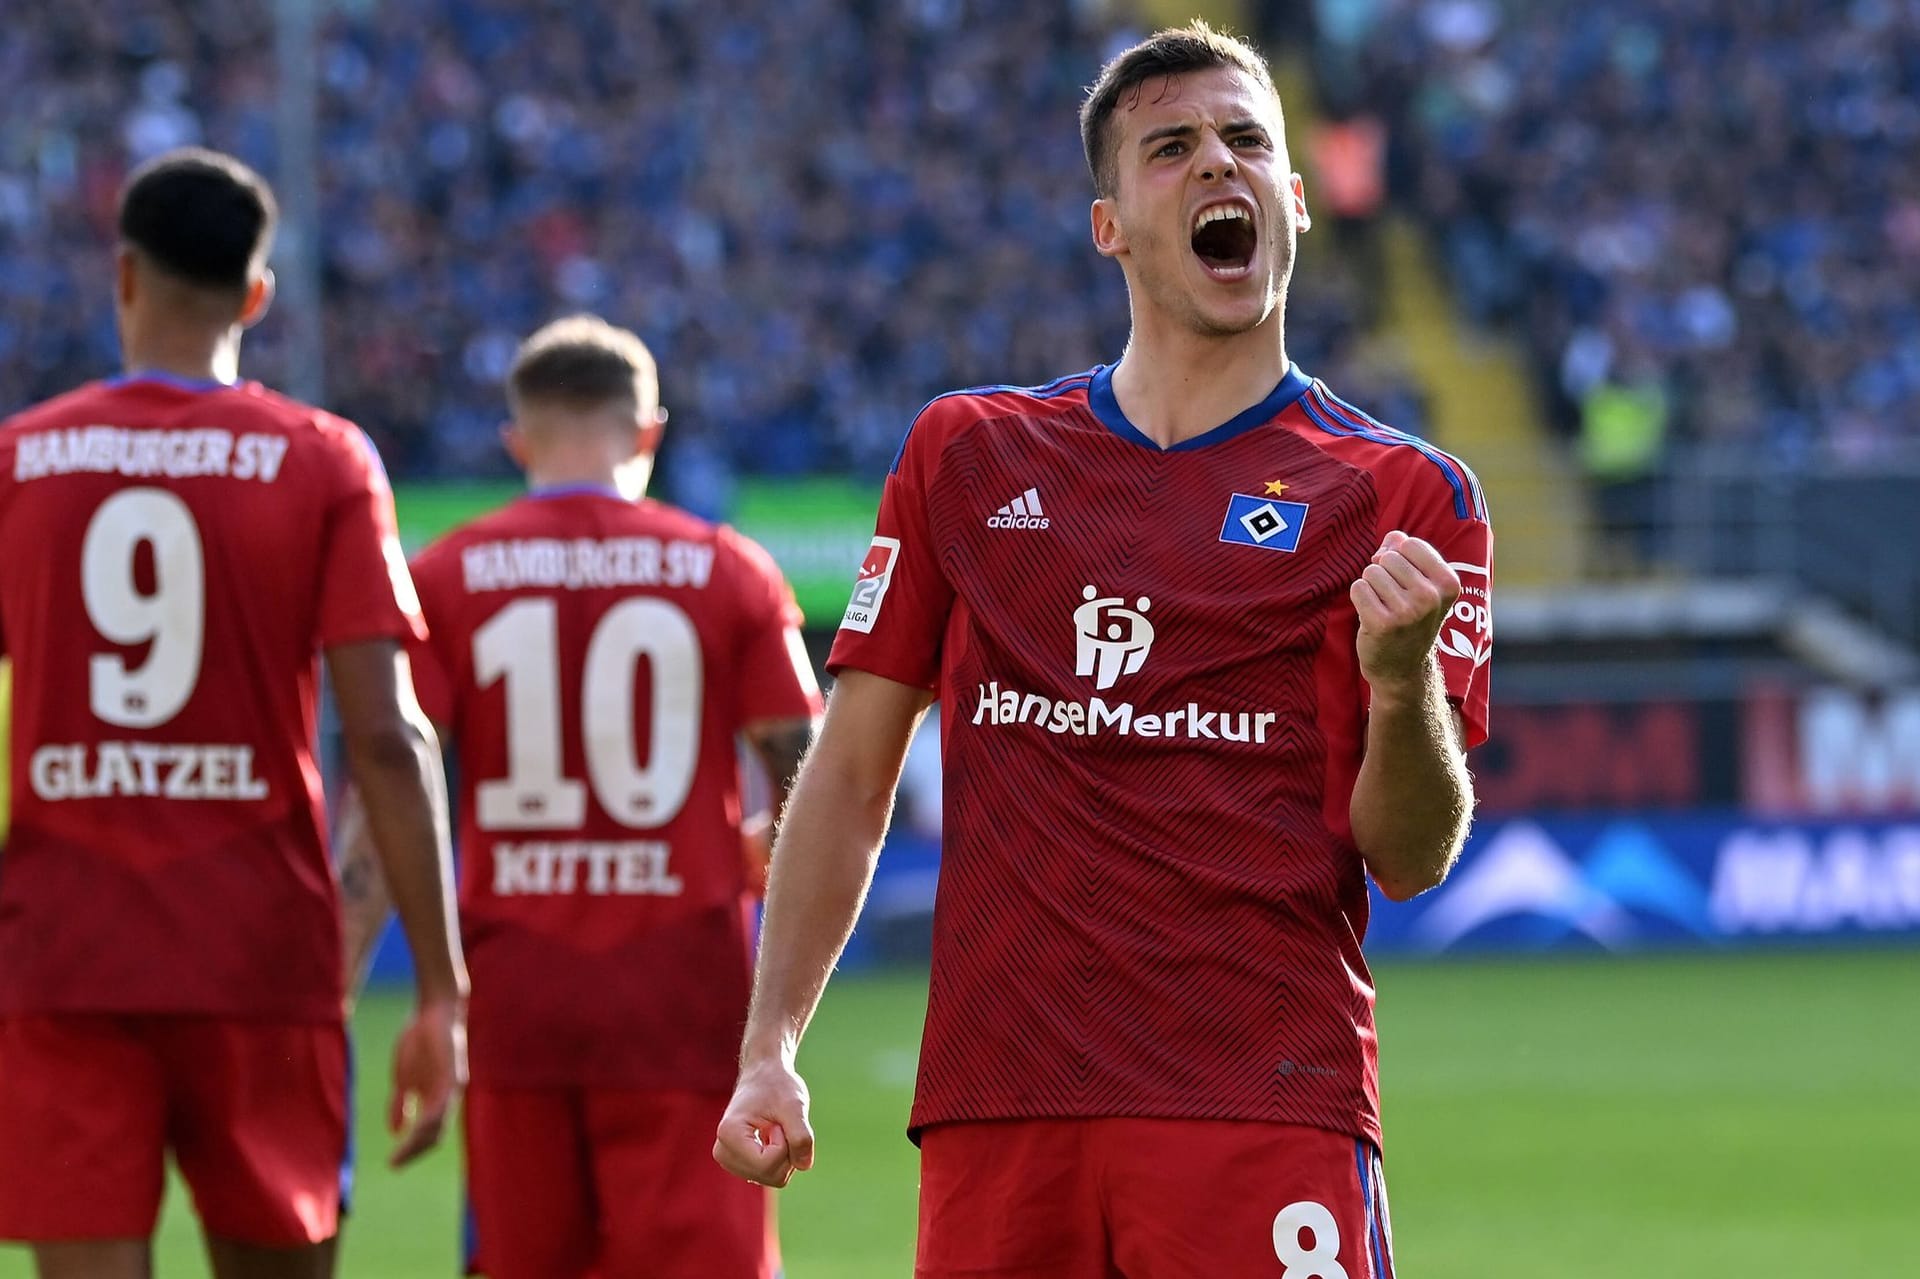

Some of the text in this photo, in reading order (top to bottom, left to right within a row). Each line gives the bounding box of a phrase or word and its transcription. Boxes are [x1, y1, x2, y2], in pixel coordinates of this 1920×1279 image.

[14, 425, 288, 482] HAMBURGER SV
[987, 513, 1050, 529] adidas
[462, 537, 713, 591] HAMBURGER SV
[857, 579, 880, 604] 2
[82, 487, 204, 728] 9
[472, 596, 702, 830] 10
[971, 682, 1276, 744] HanseMerkur
[31, 743, 267, 799] GLATZEL
[494, 841, 681, 894] KITTEL
[1272, 1200, 1350, 1279] 8
